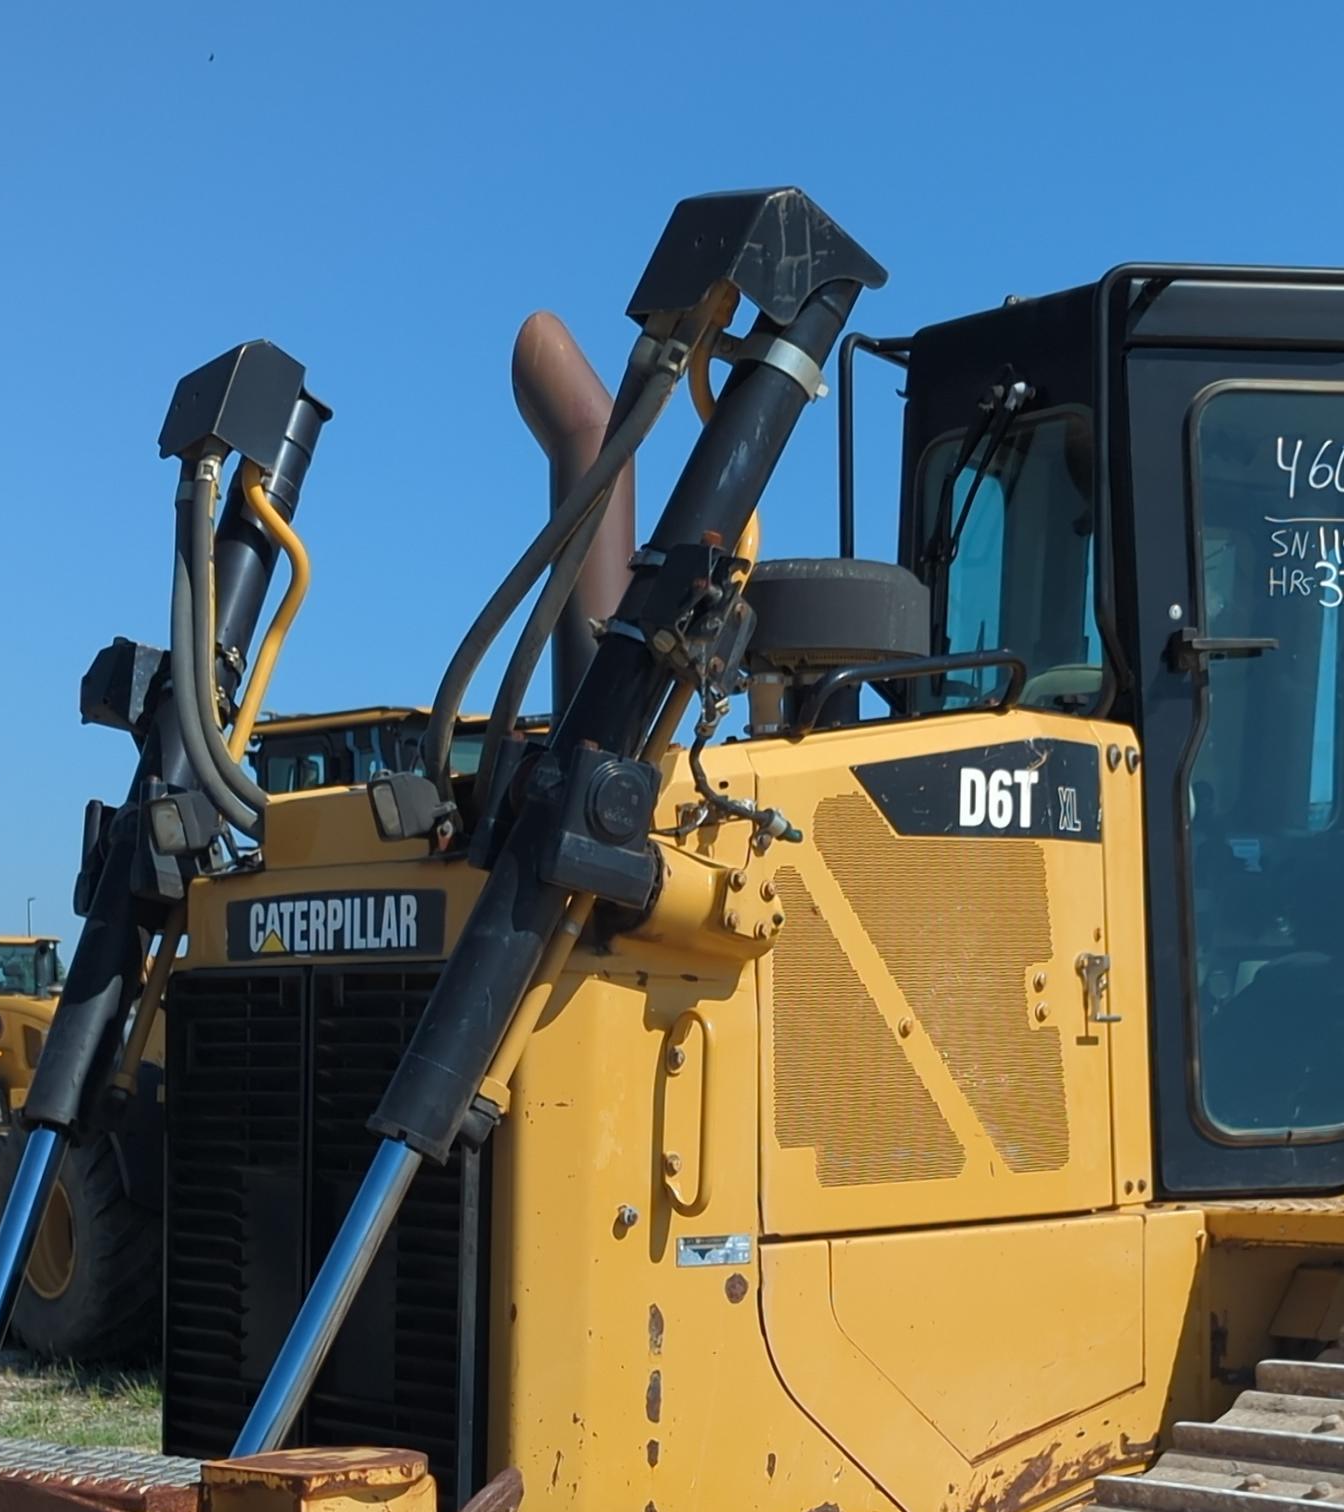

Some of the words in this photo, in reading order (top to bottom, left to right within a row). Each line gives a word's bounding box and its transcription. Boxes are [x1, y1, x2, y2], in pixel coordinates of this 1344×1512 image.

[959, 767, 1039, 829] D6T
[1057, 786, 1082, 832] XL
[249, 894, 417, 953] CATERPILLAR
